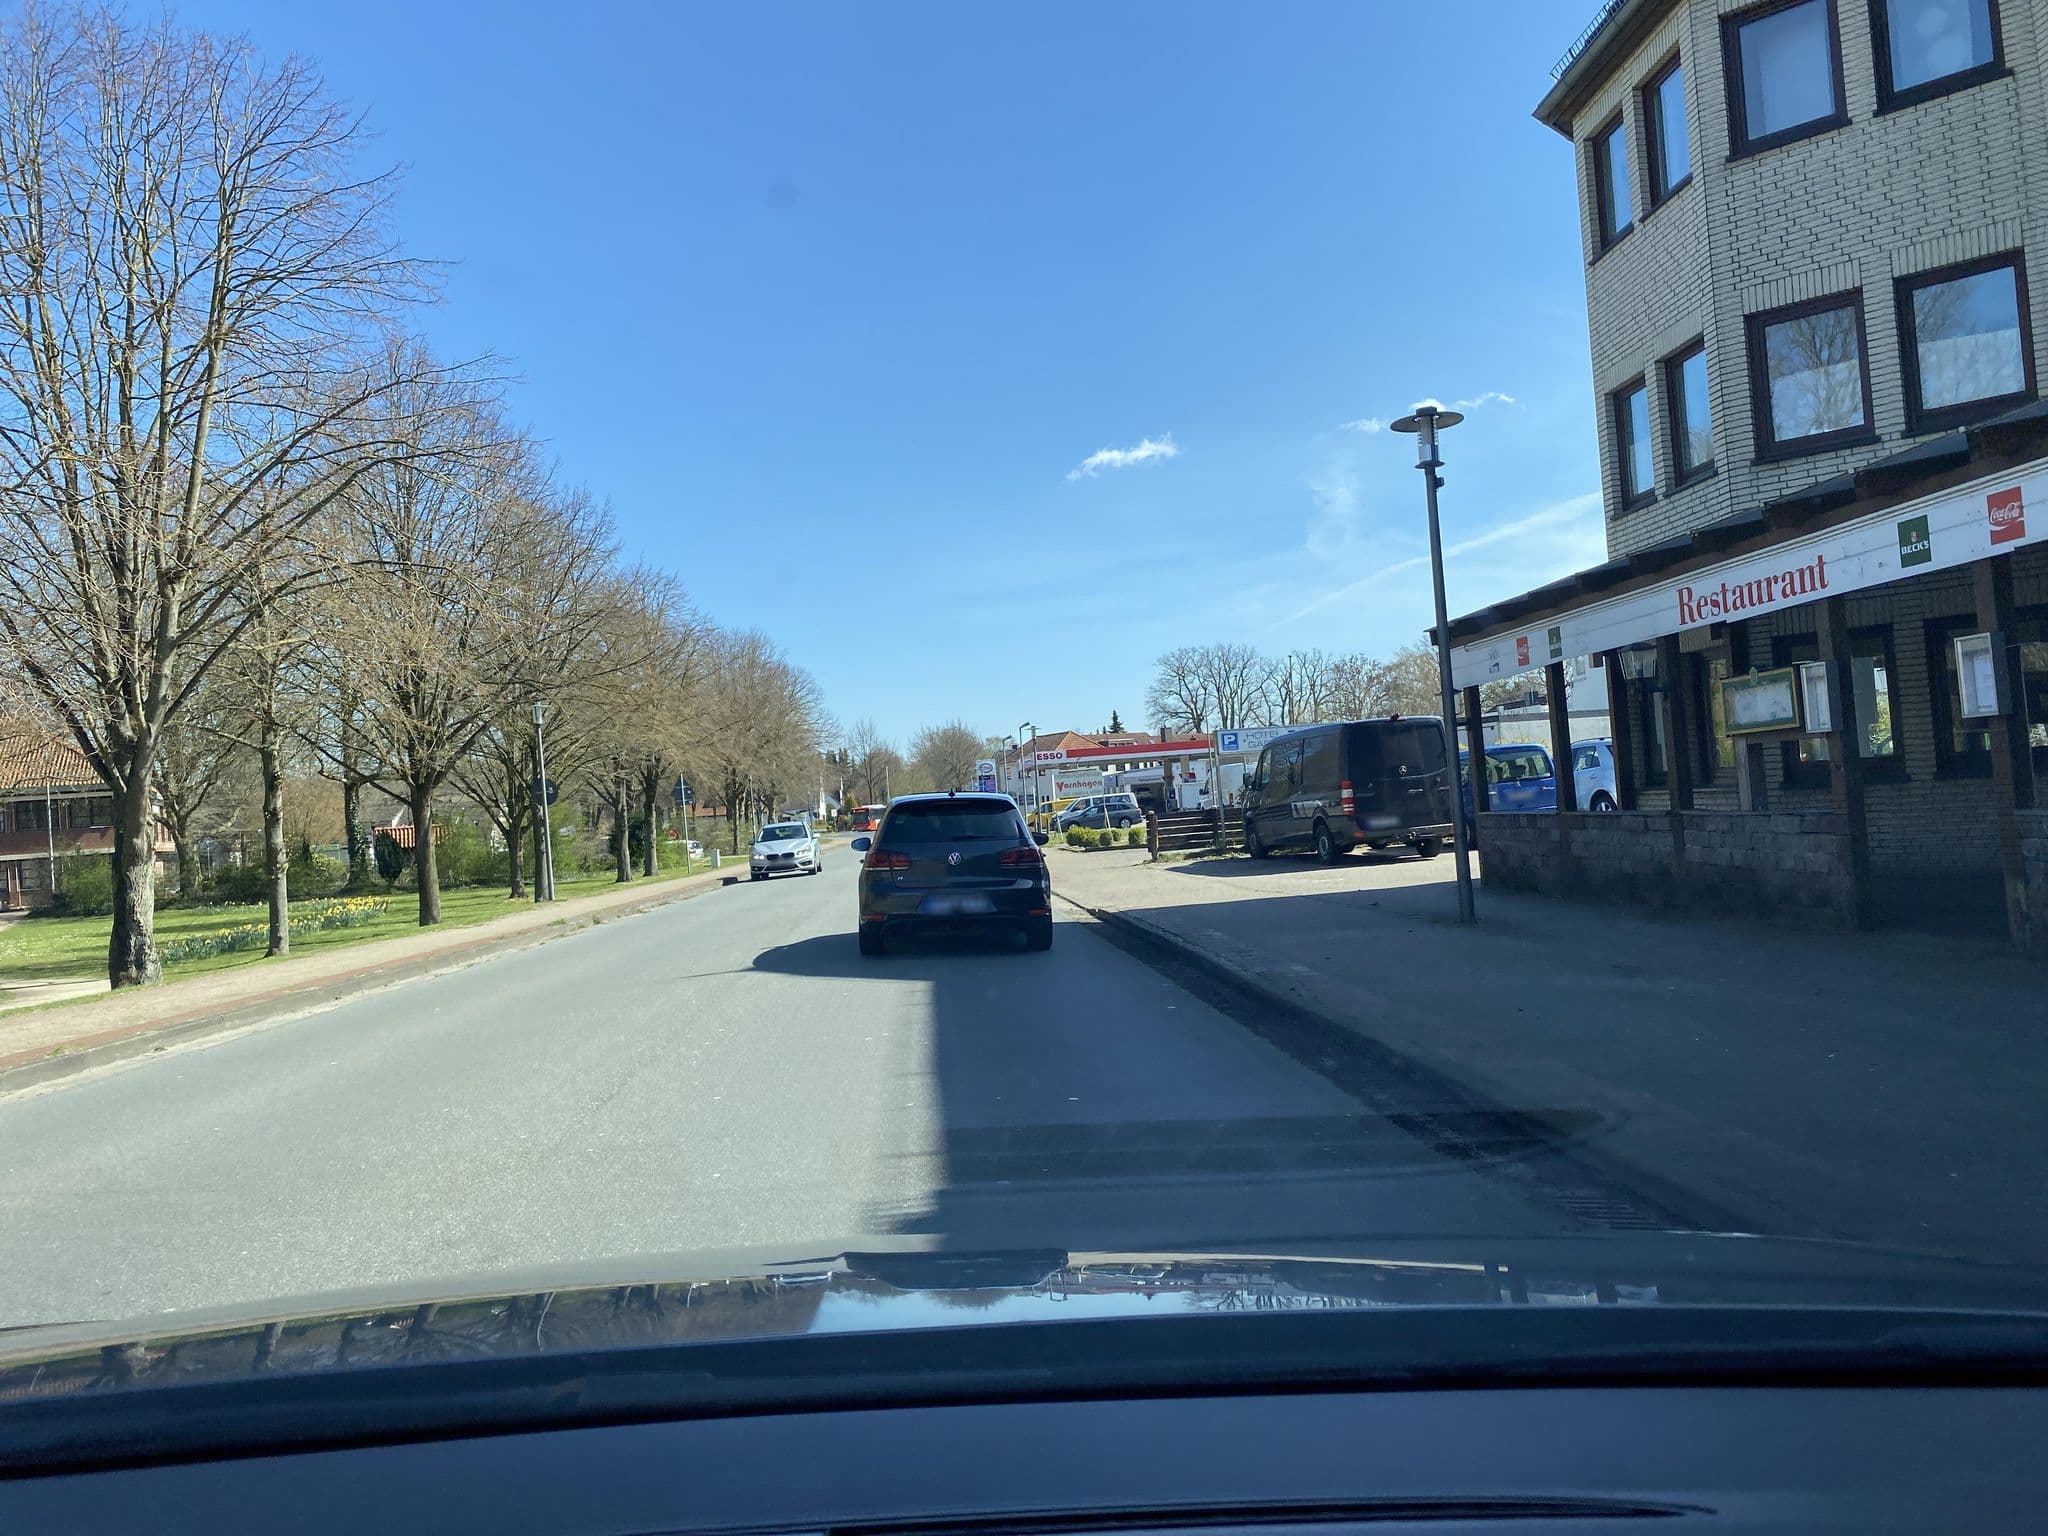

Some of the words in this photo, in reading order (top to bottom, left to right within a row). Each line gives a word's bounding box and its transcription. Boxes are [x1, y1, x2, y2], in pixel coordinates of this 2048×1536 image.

[1901, 540, 1930, 555] BECK'S
[1675, 554, 1829, 626] Restaurant
[1223, 734, 1236, 745] P
[1036, 752, 1063, 760] ESSO
